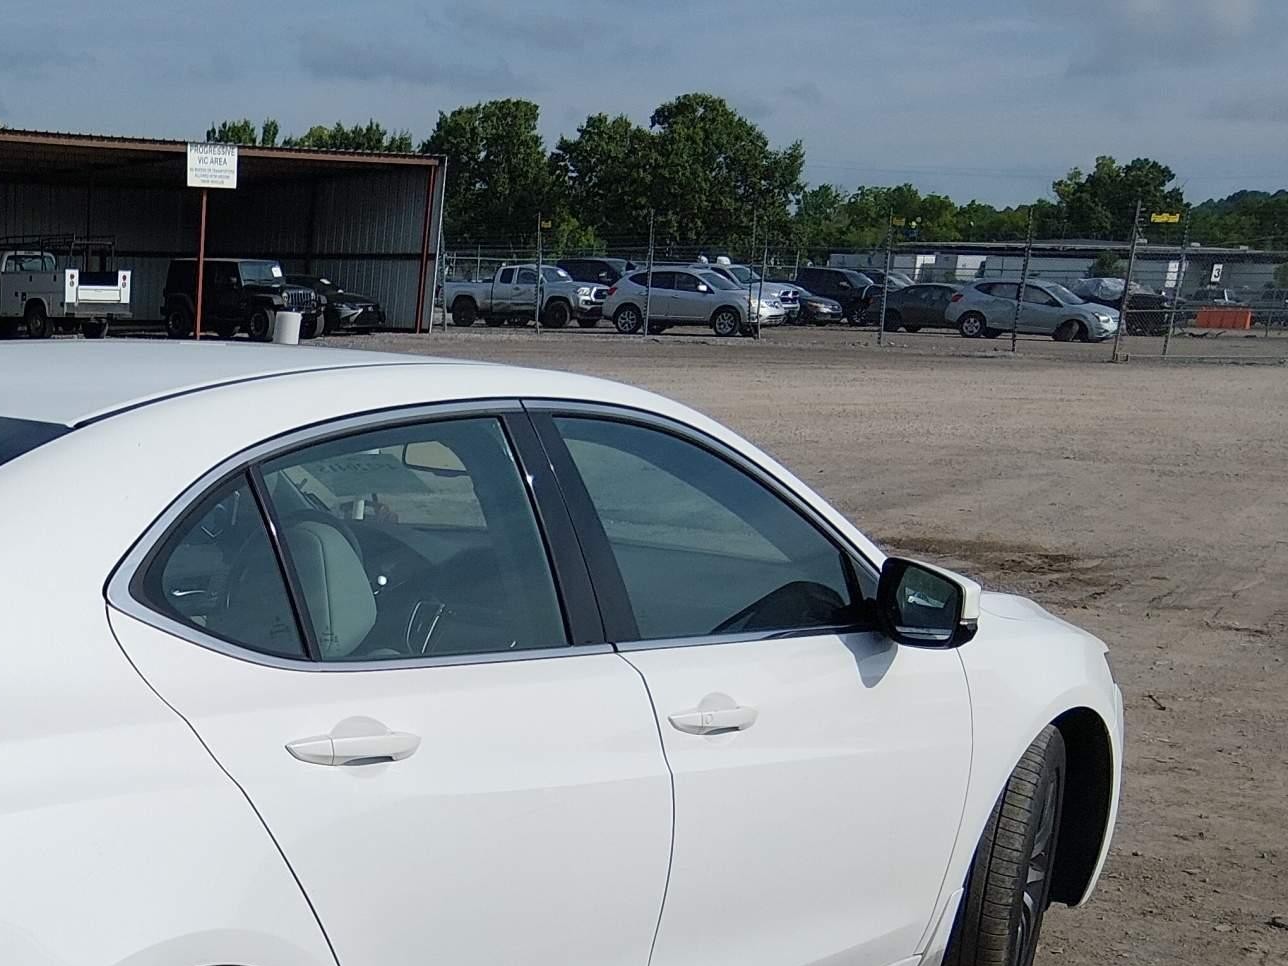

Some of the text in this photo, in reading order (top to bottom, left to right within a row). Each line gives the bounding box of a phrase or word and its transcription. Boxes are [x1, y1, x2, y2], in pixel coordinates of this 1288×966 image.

[189, 144, 235, 156] PROGRESSIVE
[198, 157, 228, 166] VIC AREA
[1214, 269, 1221, 278] 3
